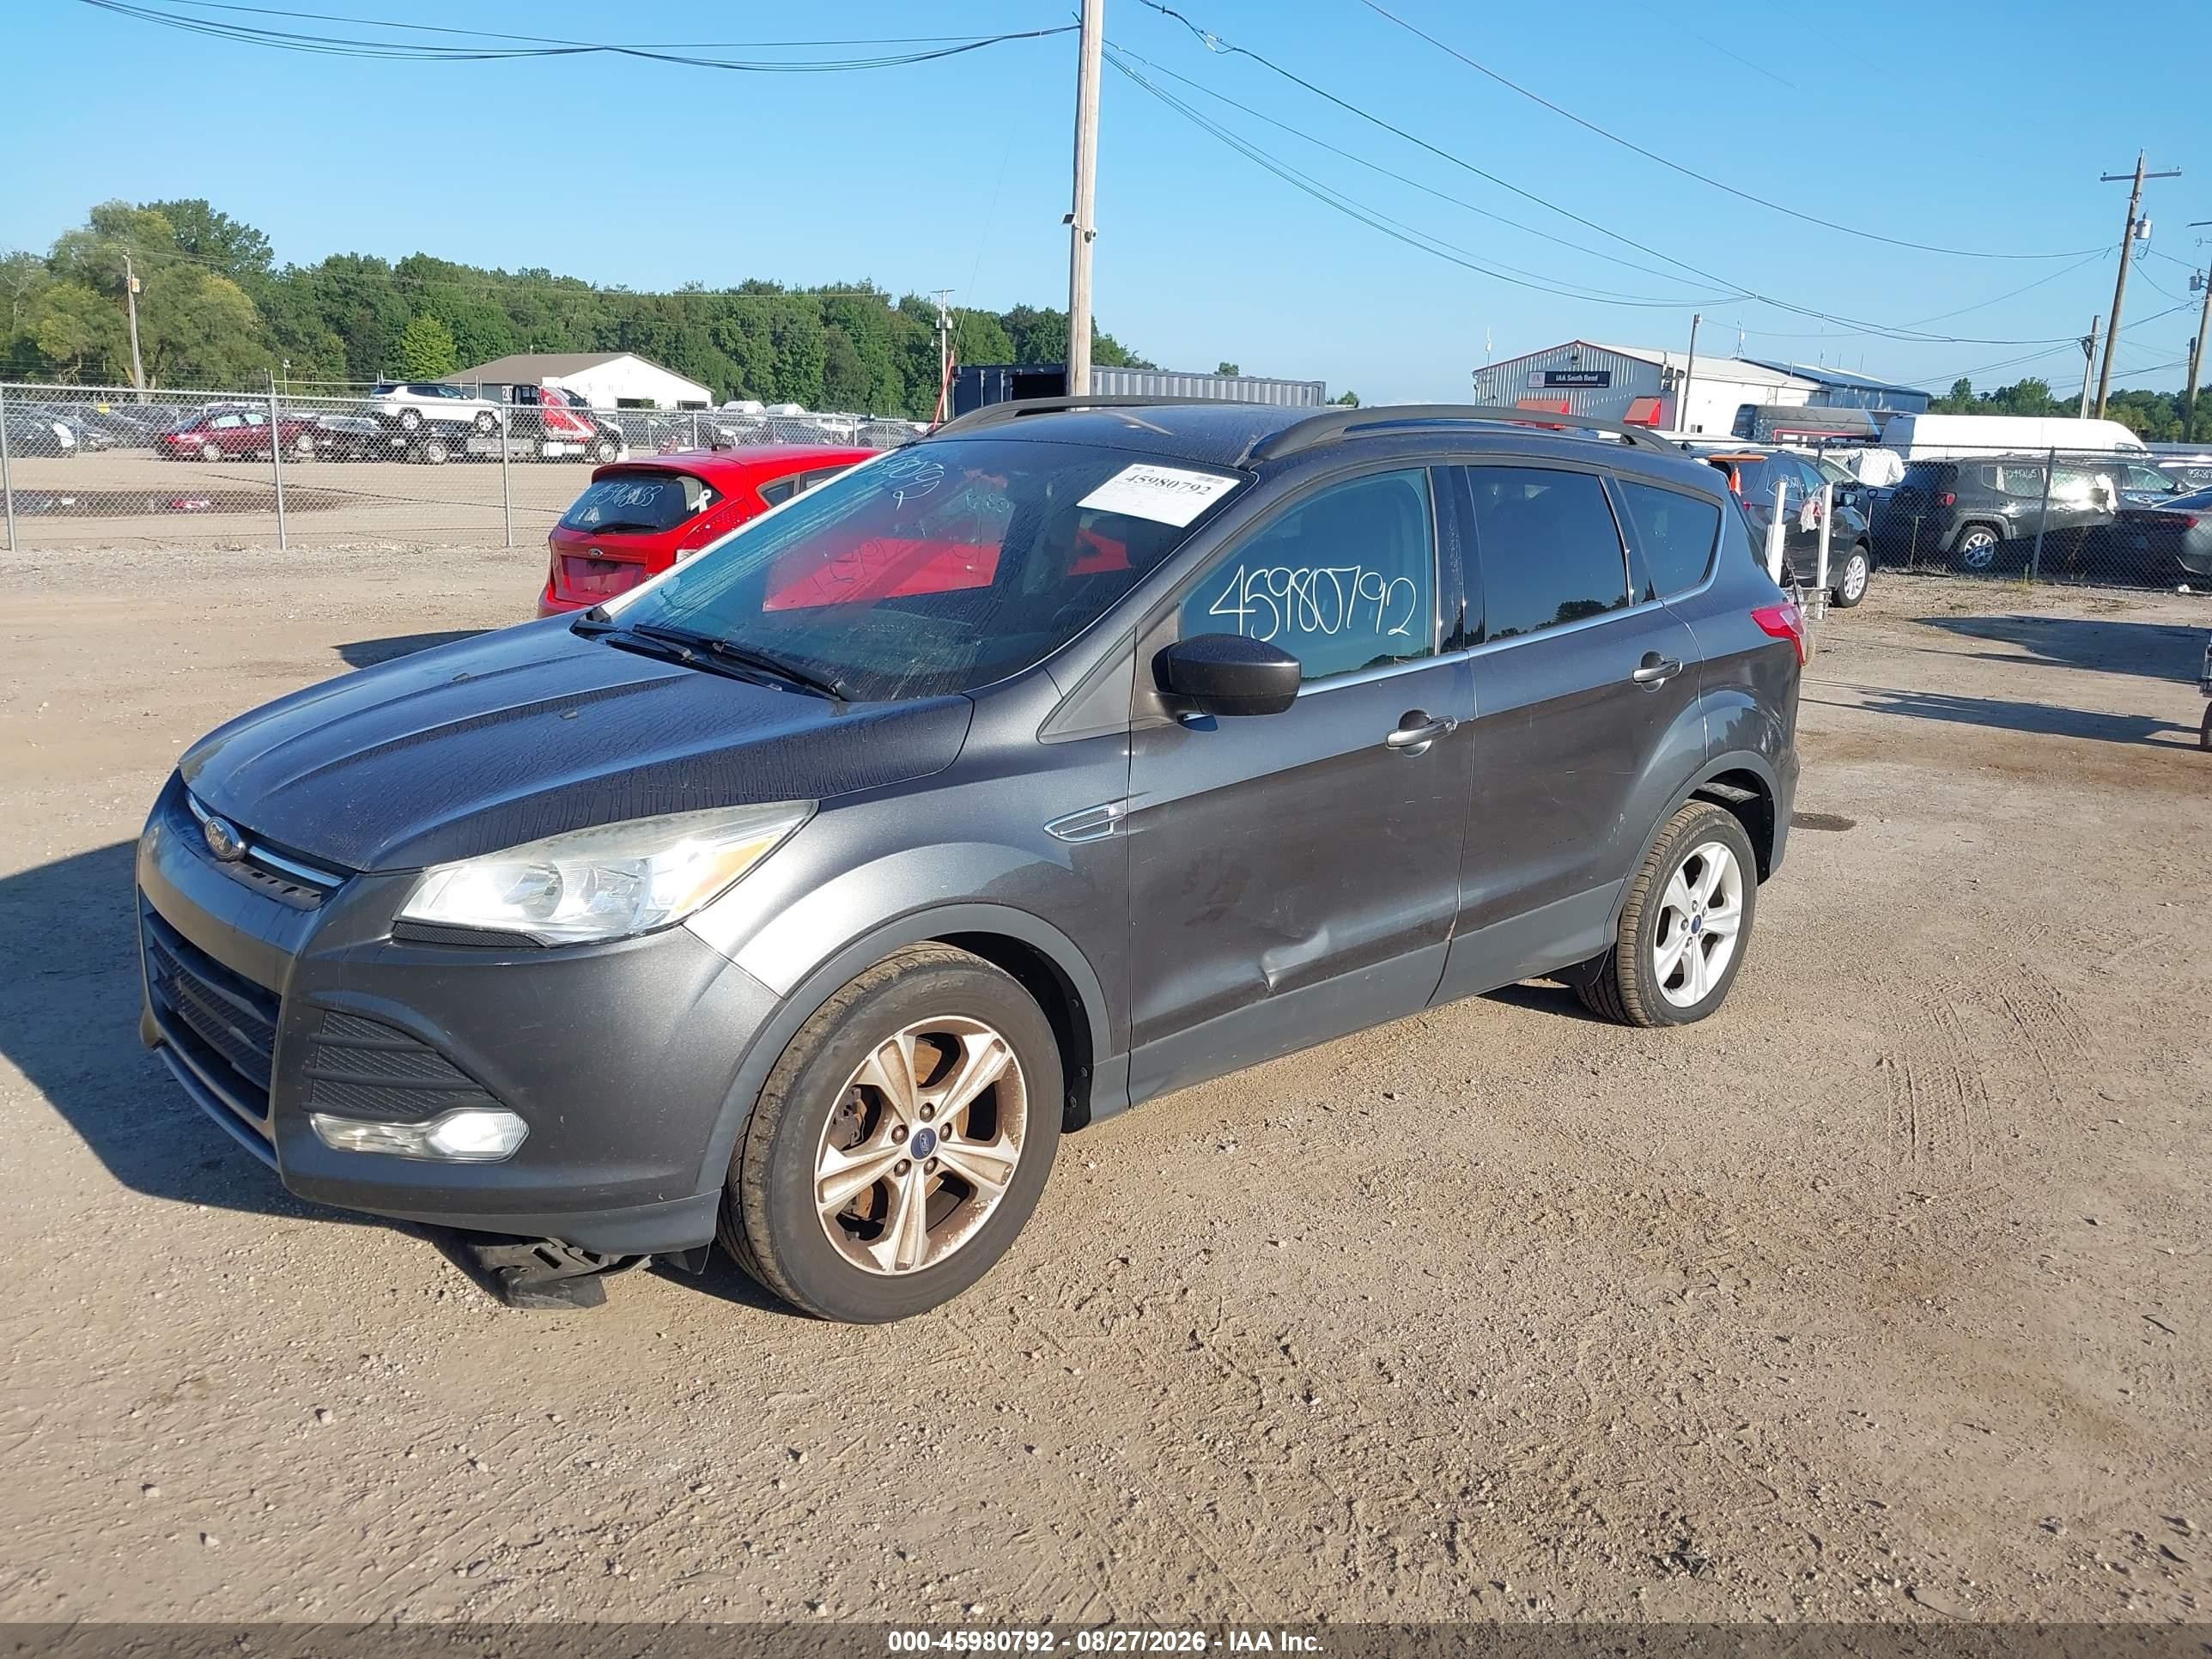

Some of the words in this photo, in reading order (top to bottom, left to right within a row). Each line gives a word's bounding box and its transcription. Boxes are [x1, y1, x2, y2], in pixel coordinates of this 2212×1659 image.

[1555, 374, 1566, 382] IAA
[1566, 374, 1583, 382] South
[1583, 374, 1599, 382] Bend
[1126, 474, 1212, 495] 45980792
[1209, 564, 1417, 642] 45980792
